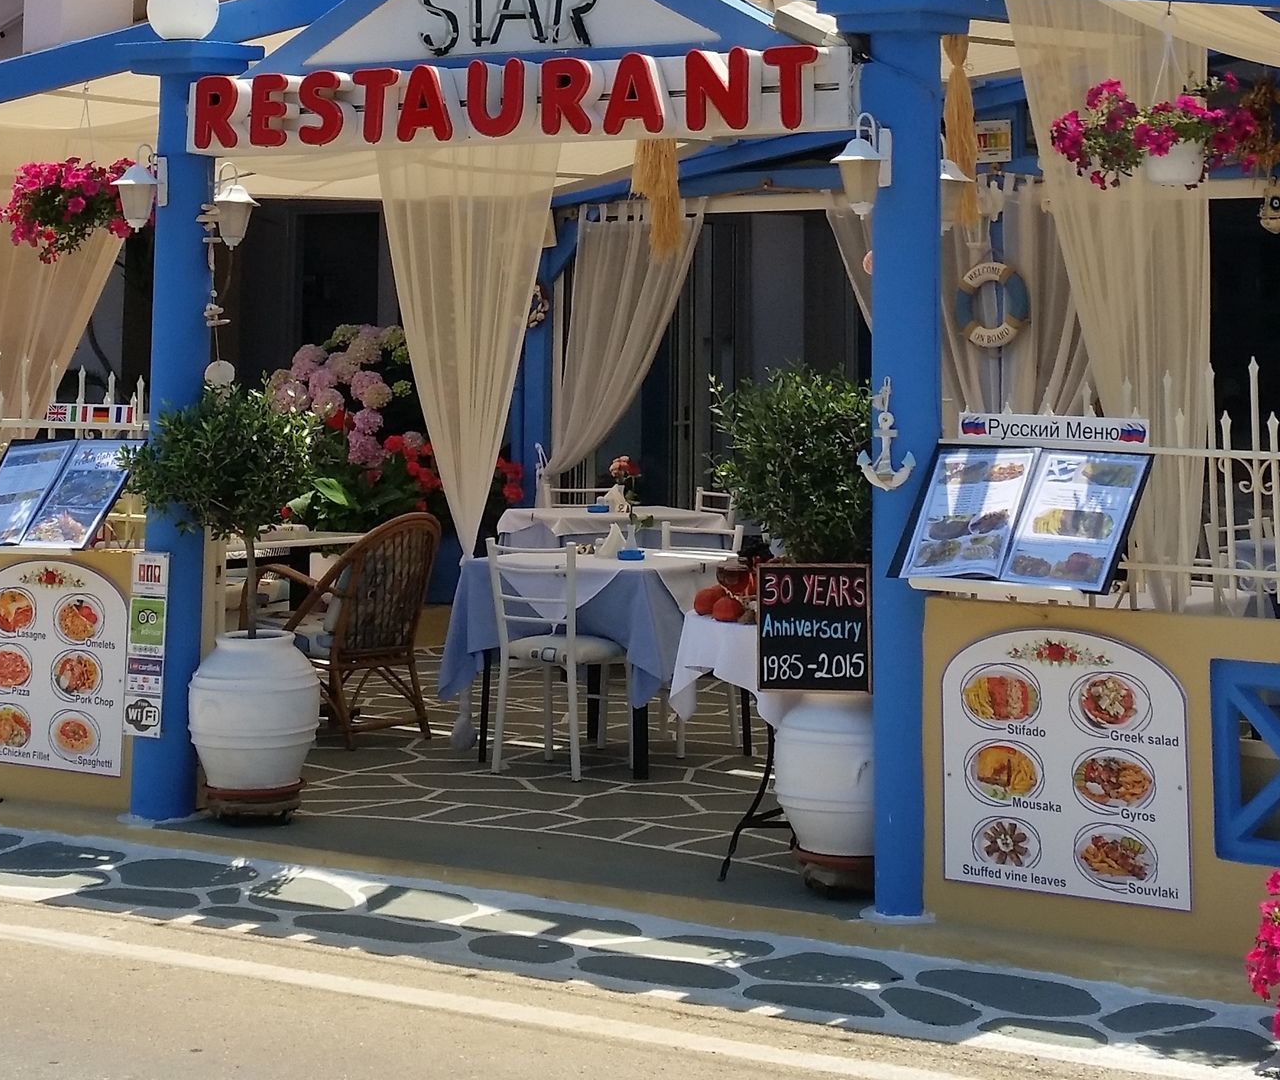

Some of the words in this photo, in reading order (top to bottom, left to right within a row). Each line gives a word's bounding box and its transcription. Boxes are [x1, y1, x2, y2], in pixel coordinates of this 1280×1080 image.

[194, 45, 818, 150] RESTAURANT
[968, 265, 1001, 281] WELCOME
[988, 419, 1060, 441] Русский
[1066, 421, 1119, 441] Меню
[762, 574, 794, 605] 30
[802, 573, 866, 608] YEARS
[16, 629, 47, 642] Lasagne
[762, 613, 862, 643] Anniversary
[85, 638, 116, 650] Omelets
[763, 652, 865, 683] 1985-2015
[11, 687, 31, 697] Pizza
[75, 694, 93, 705] Pork
[94, 696, 114, 709] Chop
[1007, 723, 1047, 738] Stifado
[1110, 730, 1145, 744] Greek
[1148, 733, 1179, 747] salad
[2, 746, 32, 759] Chicken
[32, 750, 51, 762] Fillet
[77, 755, 114, 769] Spaghetti
[1012, 796, 1063, 813] Mousaka
[1120, 808, 1156, 823] Gyros
[962, 863, 1002, 879] Stuffed
[1004, 869, 1027, 883] vine
[1031, 871, 1067, 888] leaves
[1128, 881, 1179, 900] Souvlaki
